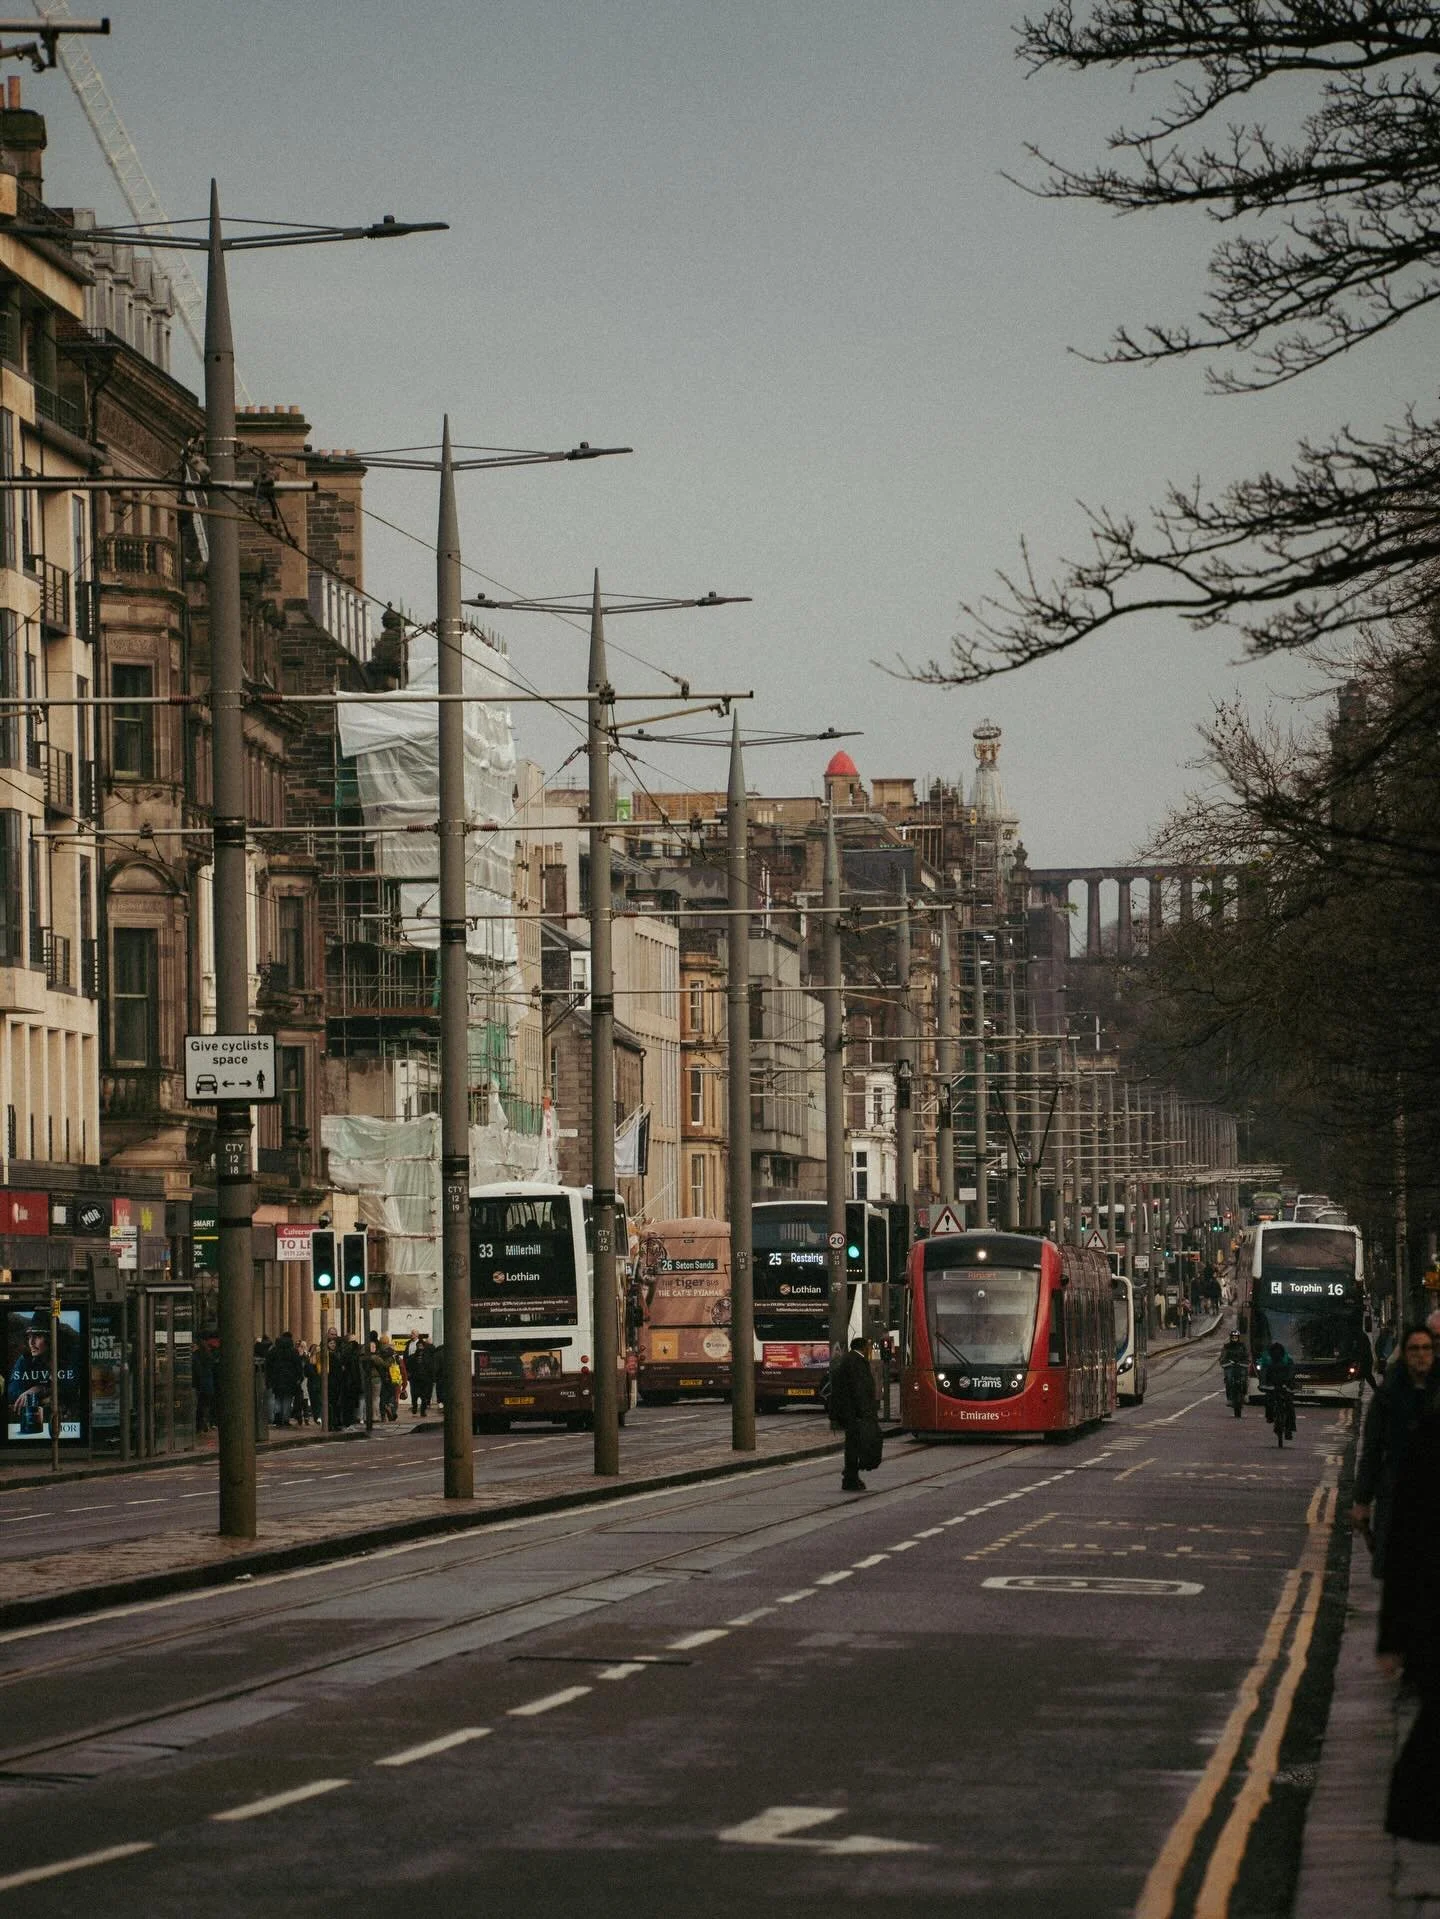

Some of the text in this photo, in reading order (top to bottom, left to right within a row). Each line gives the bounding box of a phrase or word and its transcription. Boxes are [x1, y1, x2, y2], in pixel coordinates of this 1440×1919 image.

[190, 1040, 270, 1053] Give cyclists
[212, 1056, 248, 1067] space
[225, 1143, 244, 1152] CTY
[230, 1154, 239, 1163] 12
[230, 1165, 239, 1175] 18
[447, 1185, 463, 1194] CTY
[451, 1194, 460, 1202] 12
[279, 1239, 297, 1250] TO
[830, 1236, 844, 1245] 20
[479, 1243, 541, 1258] 33 Millerhill
[768, 1253, 824, 1266] 25 Restalrig
[662, 1260, 715, 1271] 26 Seton Sands
[506, 1272, 540, 1281] Lothian
[676, 1278, 705, 1290] tiger
[658, 1289, 671, 1297] THE
[672, 1289, 691, 1297] CAT'S
[791, 1285, 821, 1294] Lothian
[1290, 1283, 1344, 1296] Torphin 16
[13, 1369, 74, 1380] SAUVGE
[972, 1377, 1002, 1388] Trams
[960, 1410, 1000, 1420] Emirates
